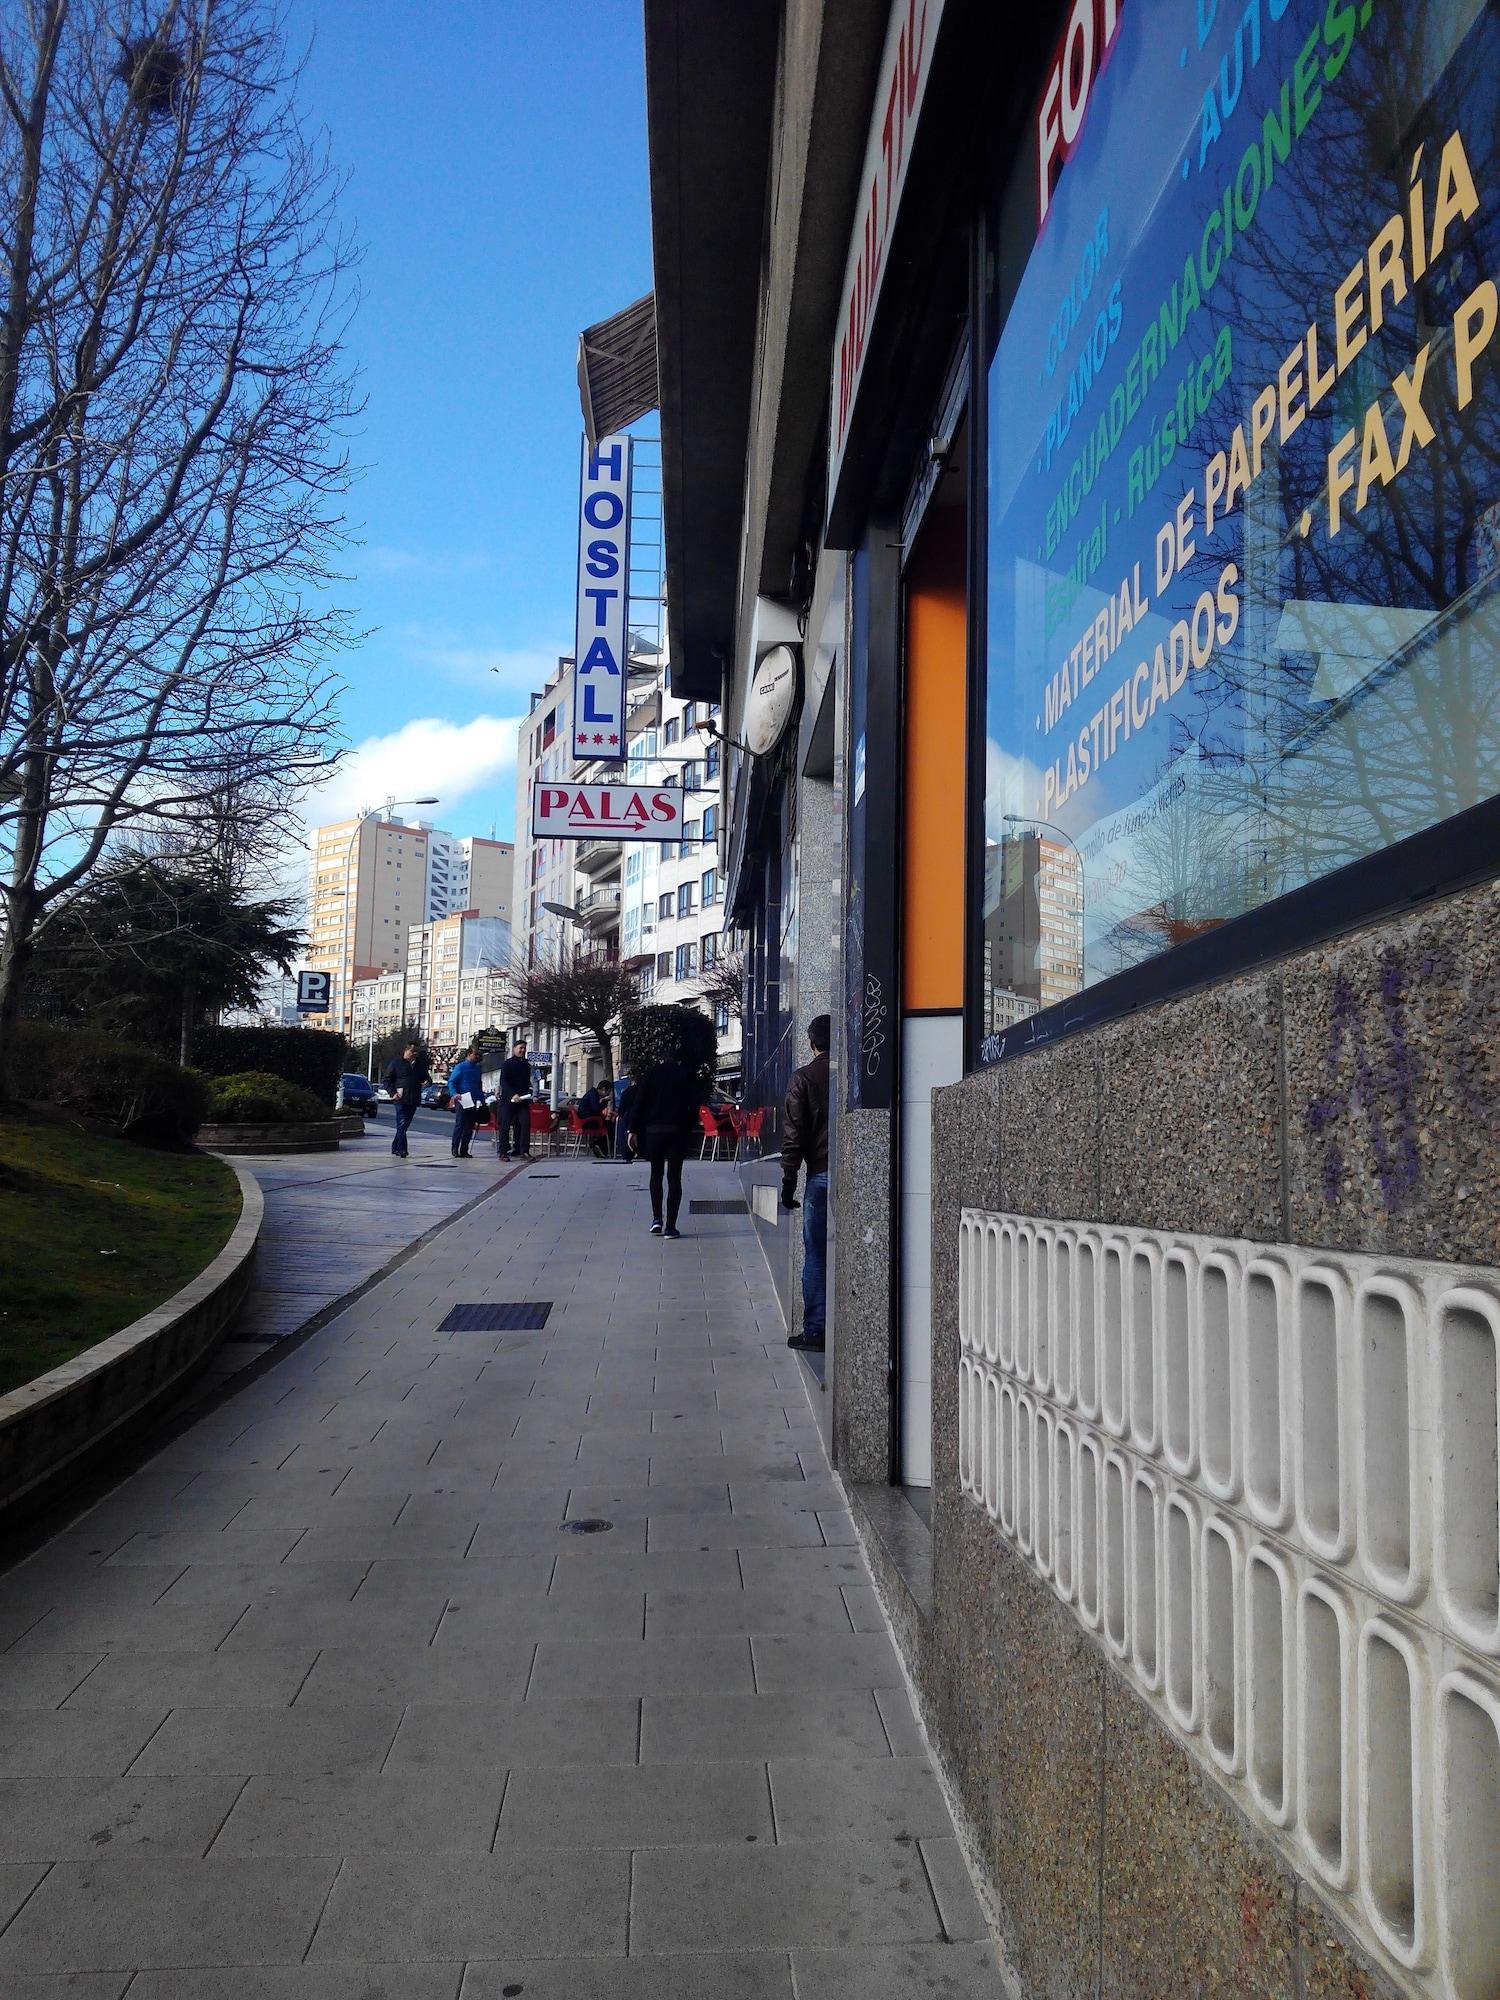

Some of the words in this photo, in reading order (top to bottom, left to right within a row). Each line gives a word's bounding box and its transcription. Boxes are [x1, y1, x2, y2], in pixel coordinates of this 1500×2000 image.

[1045, 207, 1109, 378] COLOR
[1046, 279, 1123, 472] PLANOS
[1199, 0, 1289, 174] AUT
[1044, 561, 1148, 736] MATERIAL
[1156, 487, 1196, 598] DE
[1206, 129, 1480, 537] PAPELERÍA
[1129, 323, 1232, 519] Rústica
[578, 444, 624, 723] HOSTAL
[1044, 563, 1240, 820] PLASTIFICADOS
[1328, 341, 1436, 539] FAX
[1453, 280, 1499, 412] P
[540, 789, 677, 822] PALAS
[1107, 819, 1121, 844] de
[301, 972, 326, 998] P
